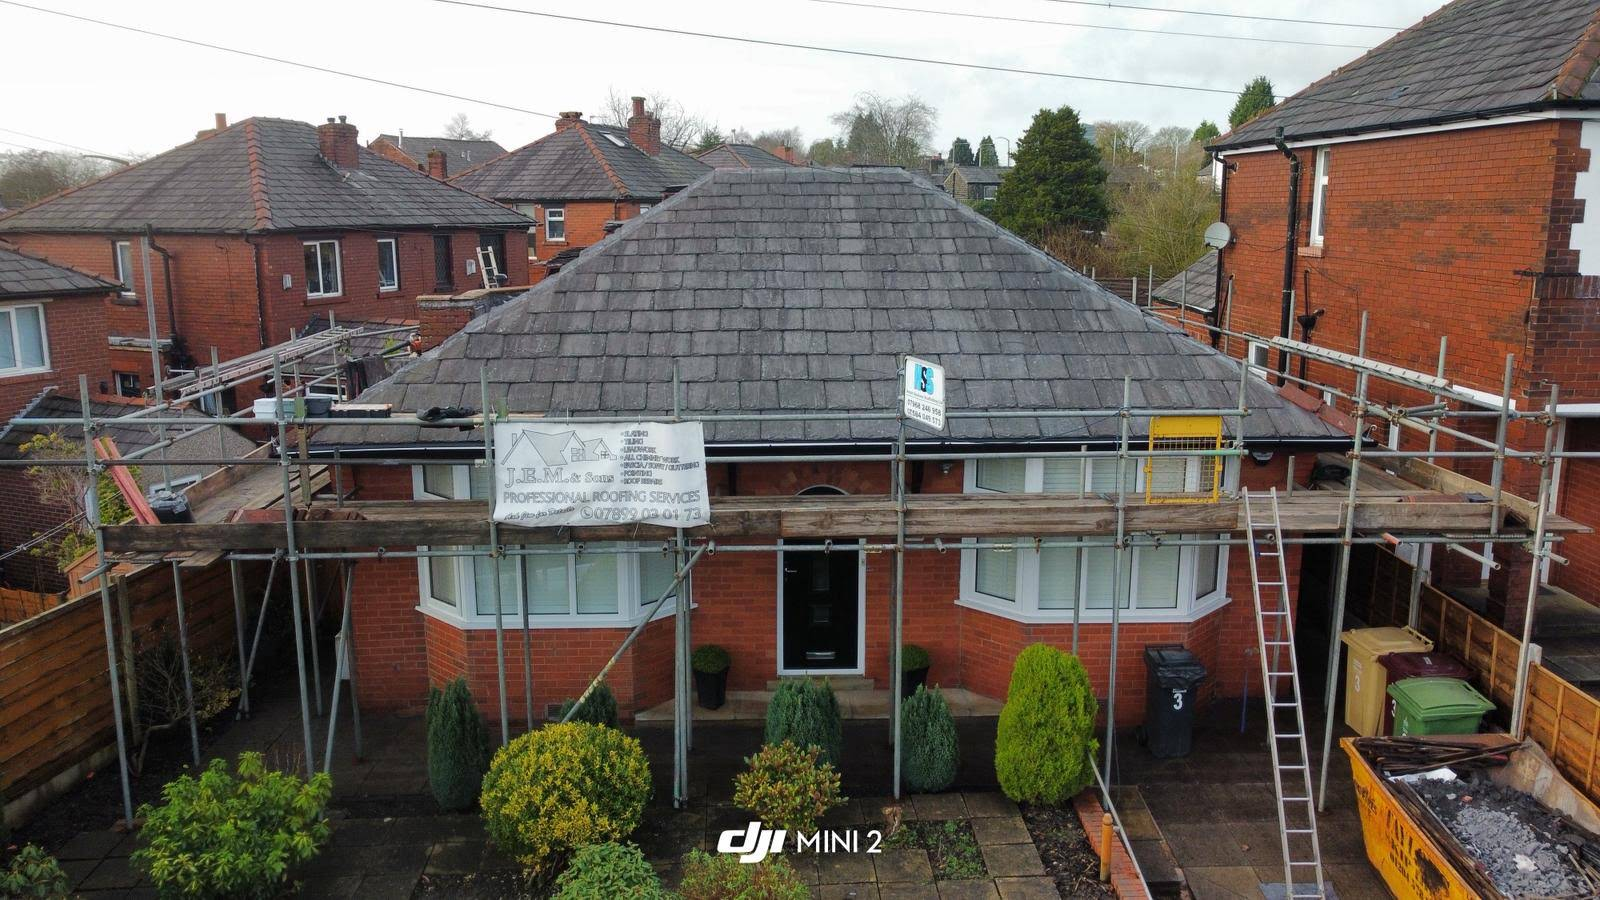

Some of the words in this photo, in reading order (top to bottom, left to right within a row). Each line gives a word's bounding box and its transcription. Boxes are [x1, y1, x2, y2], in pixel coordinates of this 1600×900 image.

[504, 467, 569, 489] J.E.M.
[570, 472, 581, 483] &
[584, 472, 615, 484] Sons
[503, 490, 590, 504] PROFESSIONAL
[592, 490, 647, 503] ROOFING
[649, 490, 700, 504] SERVICES
[1173, 693, 1183, 711] 3
